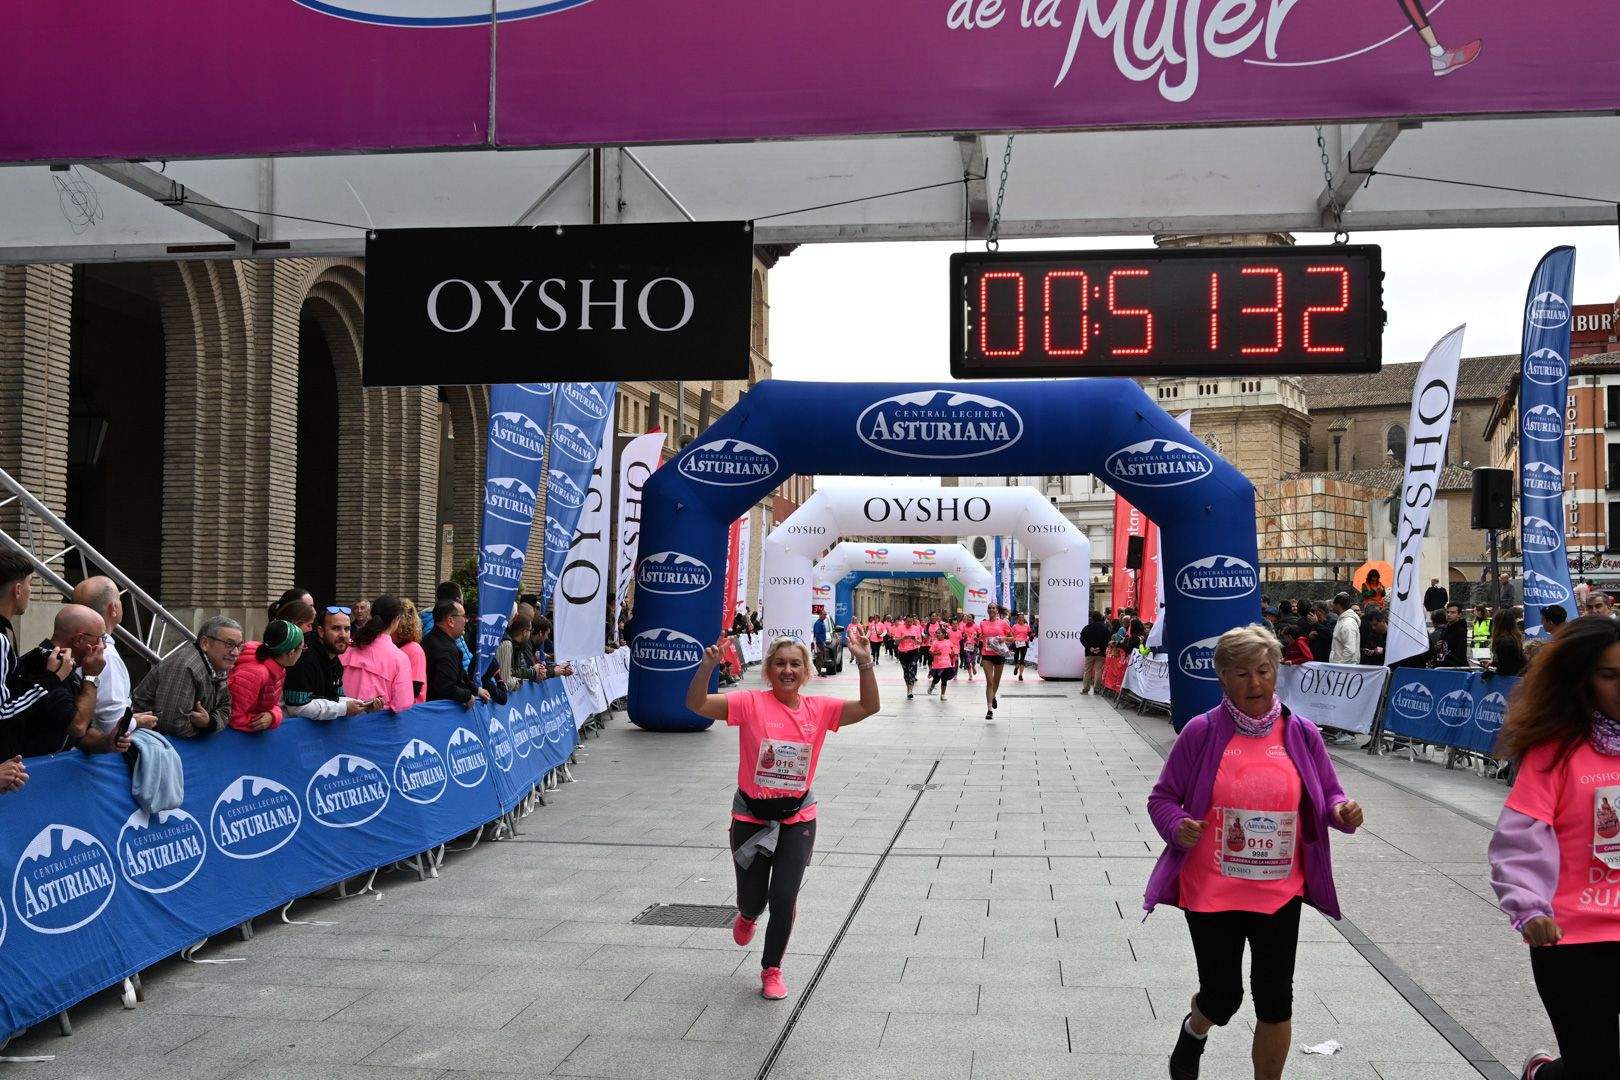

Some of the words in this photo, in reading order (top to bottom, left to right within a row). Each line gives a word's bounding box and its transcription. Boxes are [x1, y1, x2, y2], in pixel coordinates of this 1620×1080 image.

[427, 277, 694, 332] OYSHO
[869, 411, 1011, 441] ASTURIANA
[895, 410, 947, 418] CENTRAL
[952, 410, 1005, 418] LECHERA
[1567, 394, 1577, 461] HOTEL
[552, 428, 592, 460] ASTURIANA
[684, 455, 771, 475] ASTURIANA
[1115, 459, 1206, 476] ASTURIANA
[1397, 378, 1451, 602] OYSHO
[863, 496, 991, 522] OYSHO
[1568, 471, 1579, 538] TIBUR
[787, 526, 826, 535] OYSHO
[1027, 524, 1066, 534] OYSHO
[640, 566, 706, 586] ASTURIANA
[769, 577, 805, 586] OYSHO
[1047, 578, 1084, 587] OYSHO
[1181, 573, 1254, 590] ASTURIANA
[1524, 587, 1563, 600] TURIANA
[767, 629, 803, 637] OYSHO
[633, 642, 699, 661] ASTURIANA
[1300, 668, 1363, 700] OYSHO
[451, 752, 486, 776] ASTURIANA
[776, 759, 794, 768] 016
[401, 765, 446, 792] ASTURIANA
[1580, 771, 1620, 785] OYSHO
[227, 804, 256, 818] CENTRAL
[257, 794, 288, 809] LECHERA
[315, 782, 386, 816] ASTURIANA
[220, 805, 297, 847] ASTURIANA
[1248, 838, 1273, 848] 016
[34, 857, 67, 880] CENTRAL
[69, 849, 101, 867] LECHERA
[126, 834, 202, 877] ASTURIANA
[23, 862, 112, 919] ASTURIANA
